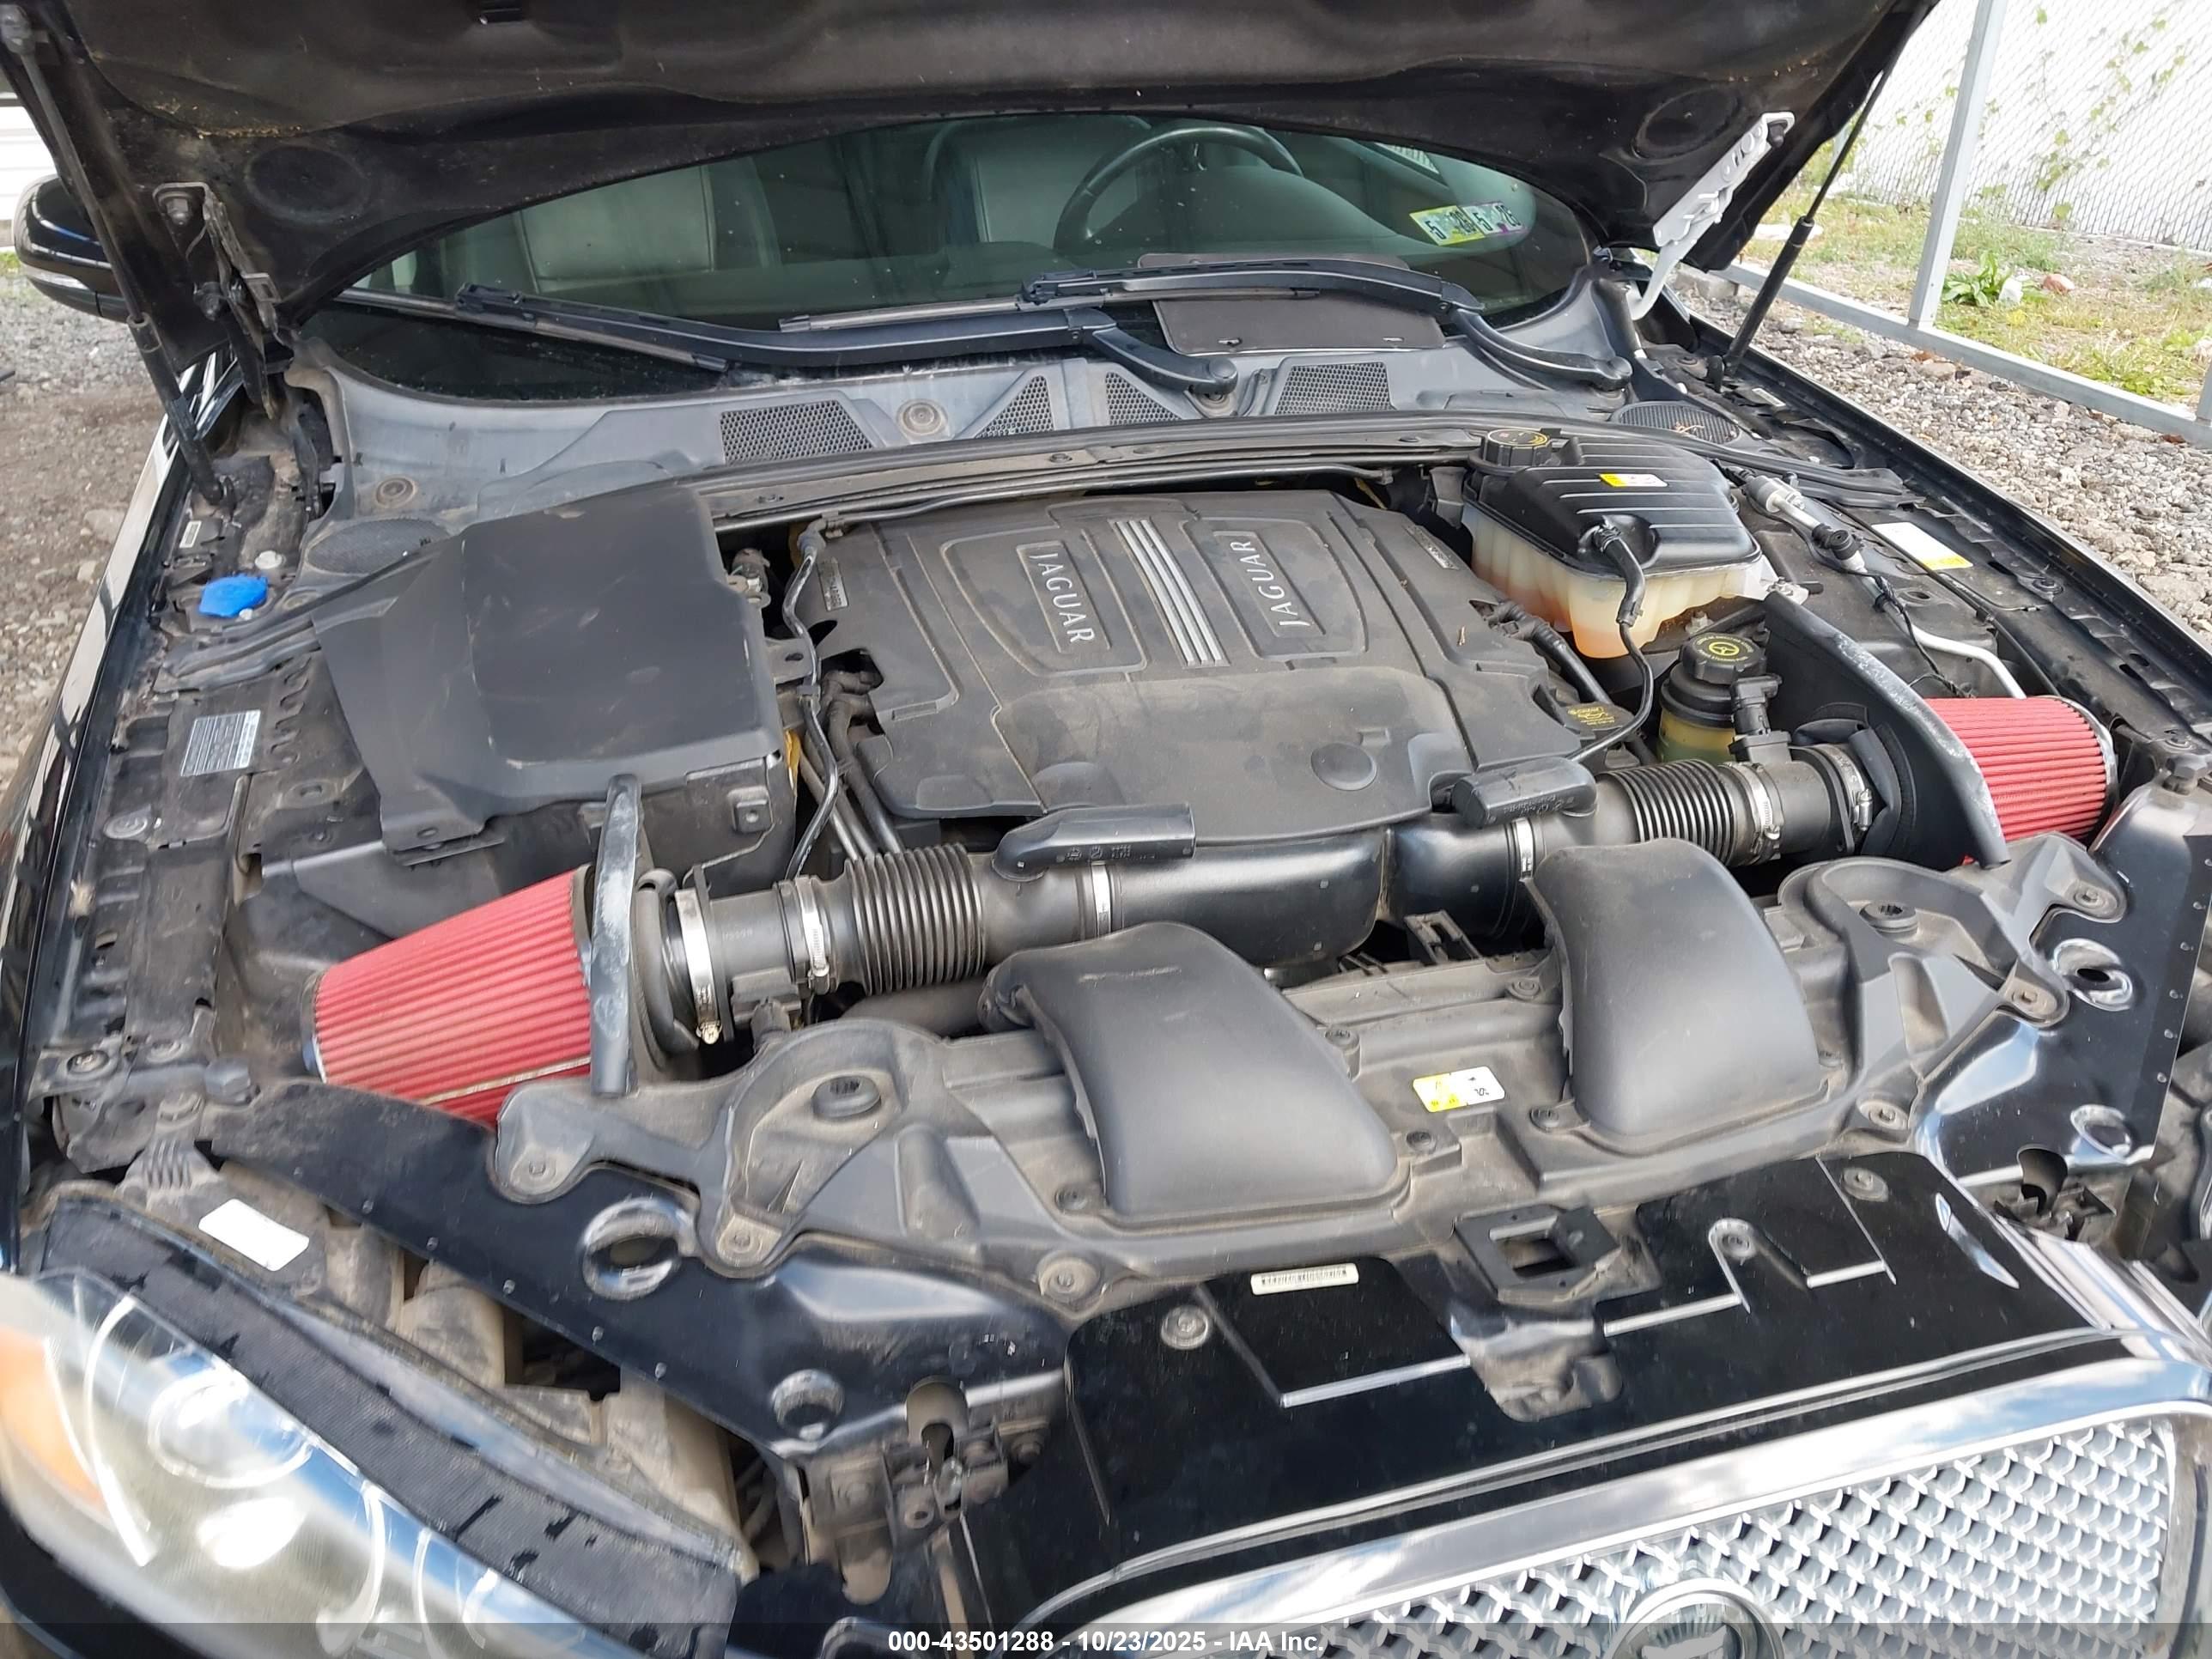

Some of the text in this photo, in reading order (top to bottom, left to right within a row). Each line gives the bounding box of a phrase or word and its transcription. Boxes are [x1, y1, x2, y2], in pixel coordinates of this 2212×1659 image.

[1424, 220, 1447, 240] 5
[1471, 211, 1493, 232] 5
[1028, 552, 1096, 643] JAGUAR
[1229, 540, 1311, 627] JAGUAR
